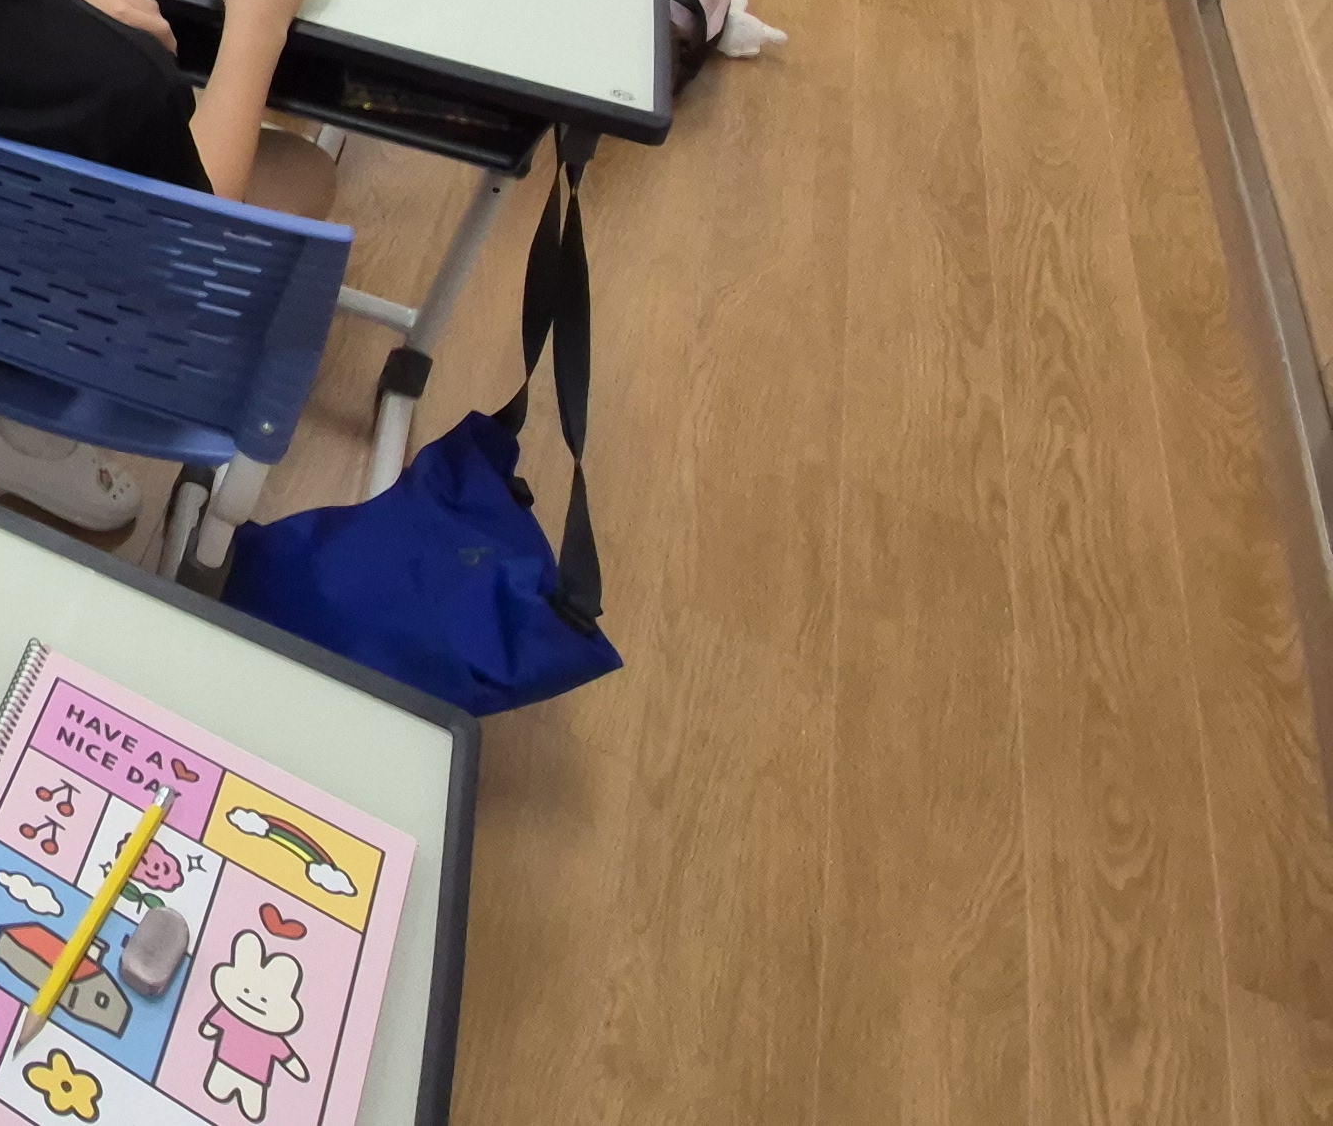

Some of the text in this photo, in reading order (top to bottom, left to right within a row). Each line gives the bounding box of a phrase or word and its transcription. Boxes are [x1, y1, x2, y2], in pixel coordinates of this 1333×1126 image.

[55, 725, 119, 771] NICE
[66, 703, 164, 770] HAVE A
